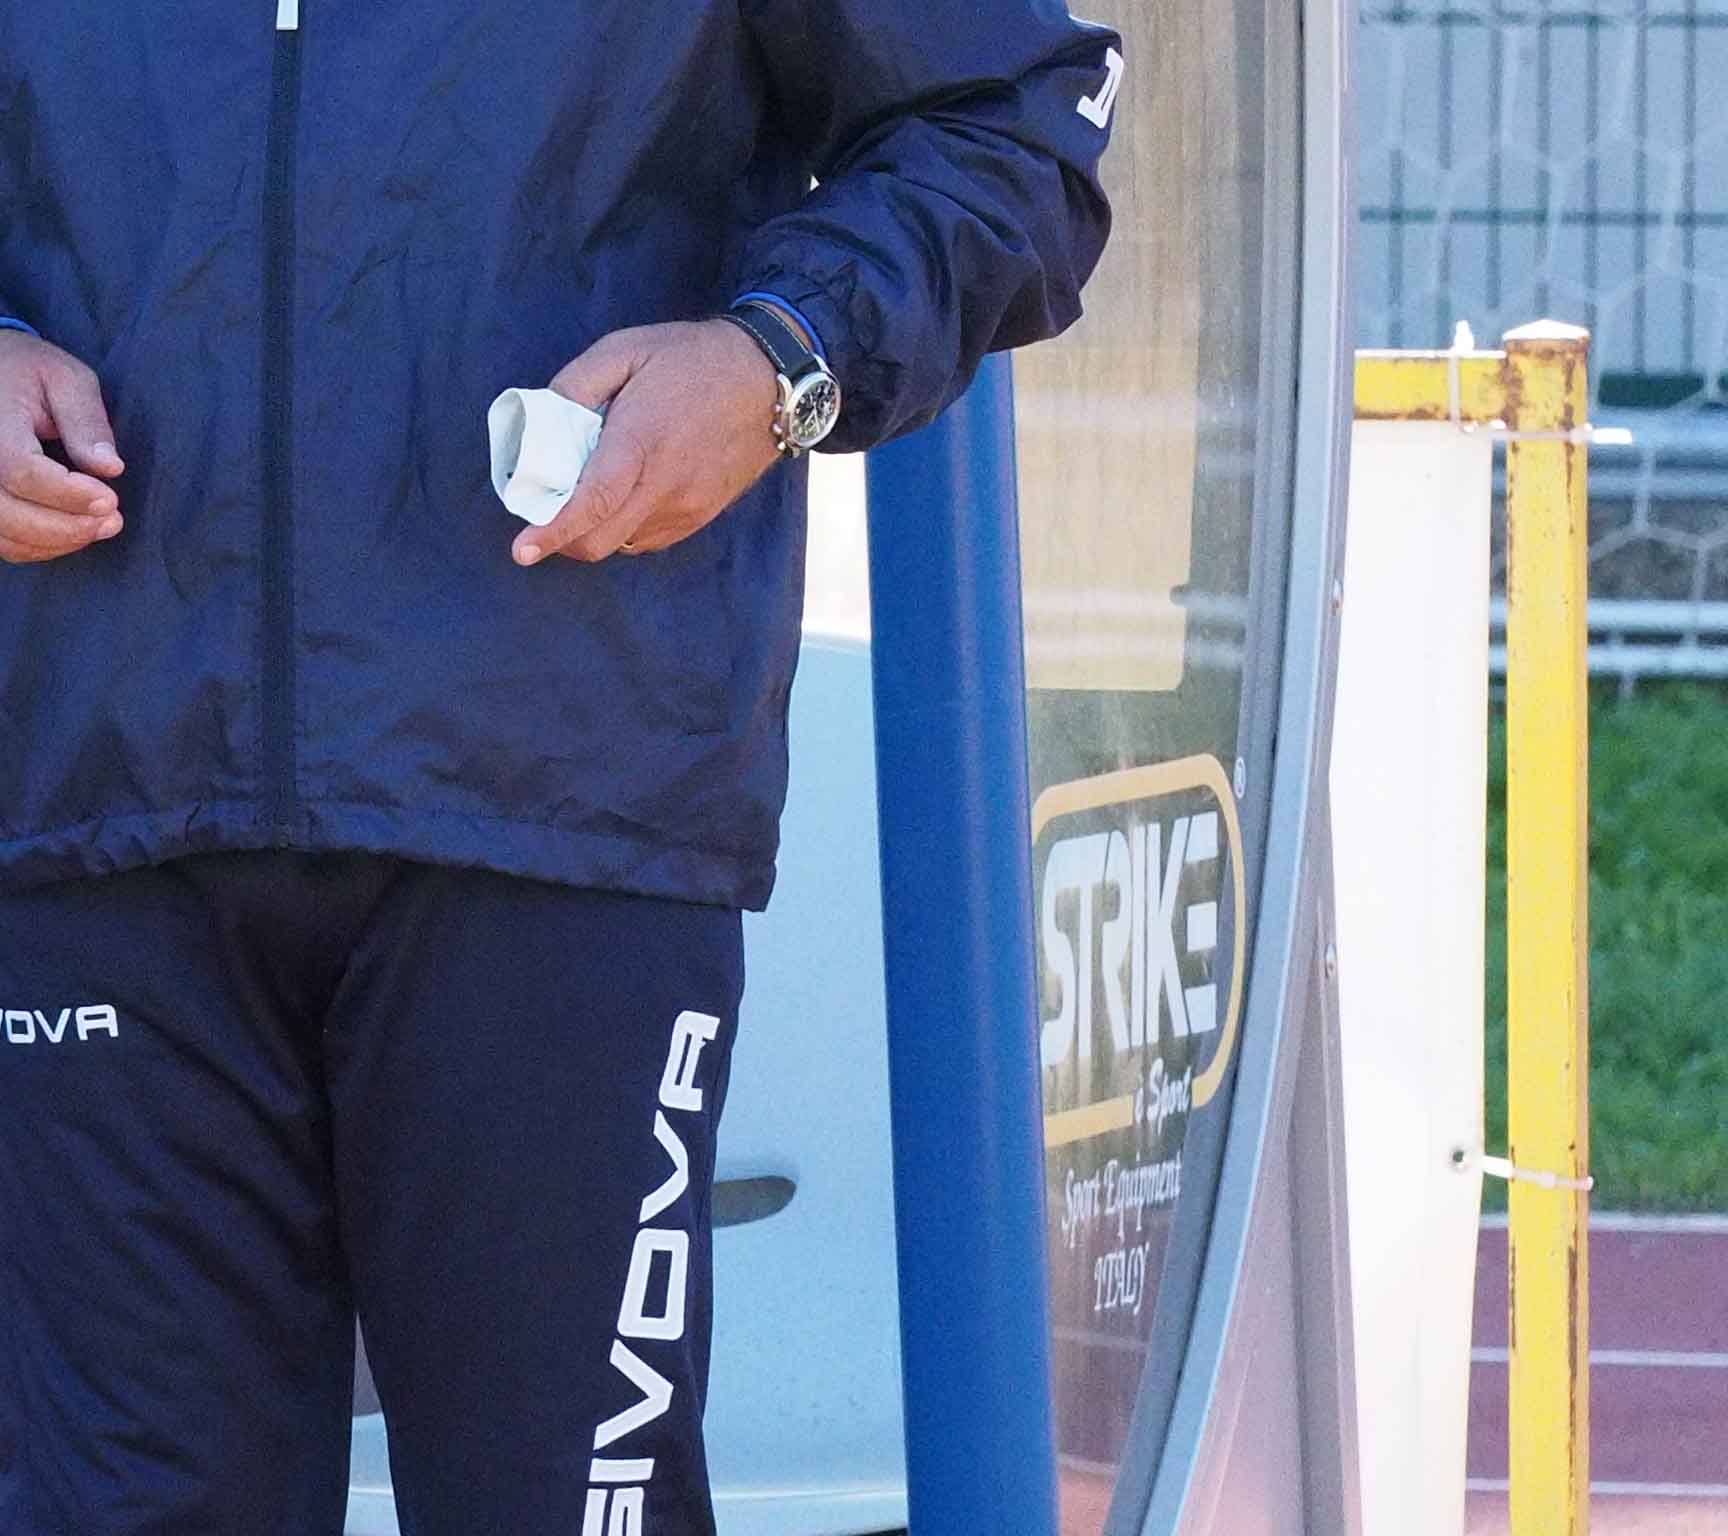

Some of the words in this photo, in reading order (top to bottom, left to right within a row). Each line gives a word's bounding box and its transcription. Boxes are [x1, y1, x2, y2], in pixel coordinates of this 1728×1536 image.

[1040, 810, 1218, 1066] STRIKE
[1145, 1056, 1192, 1137] Sport
[1061, 1167, 1101, 1250] Sport
[1104, 1151, 1182, 1246] Equipment
